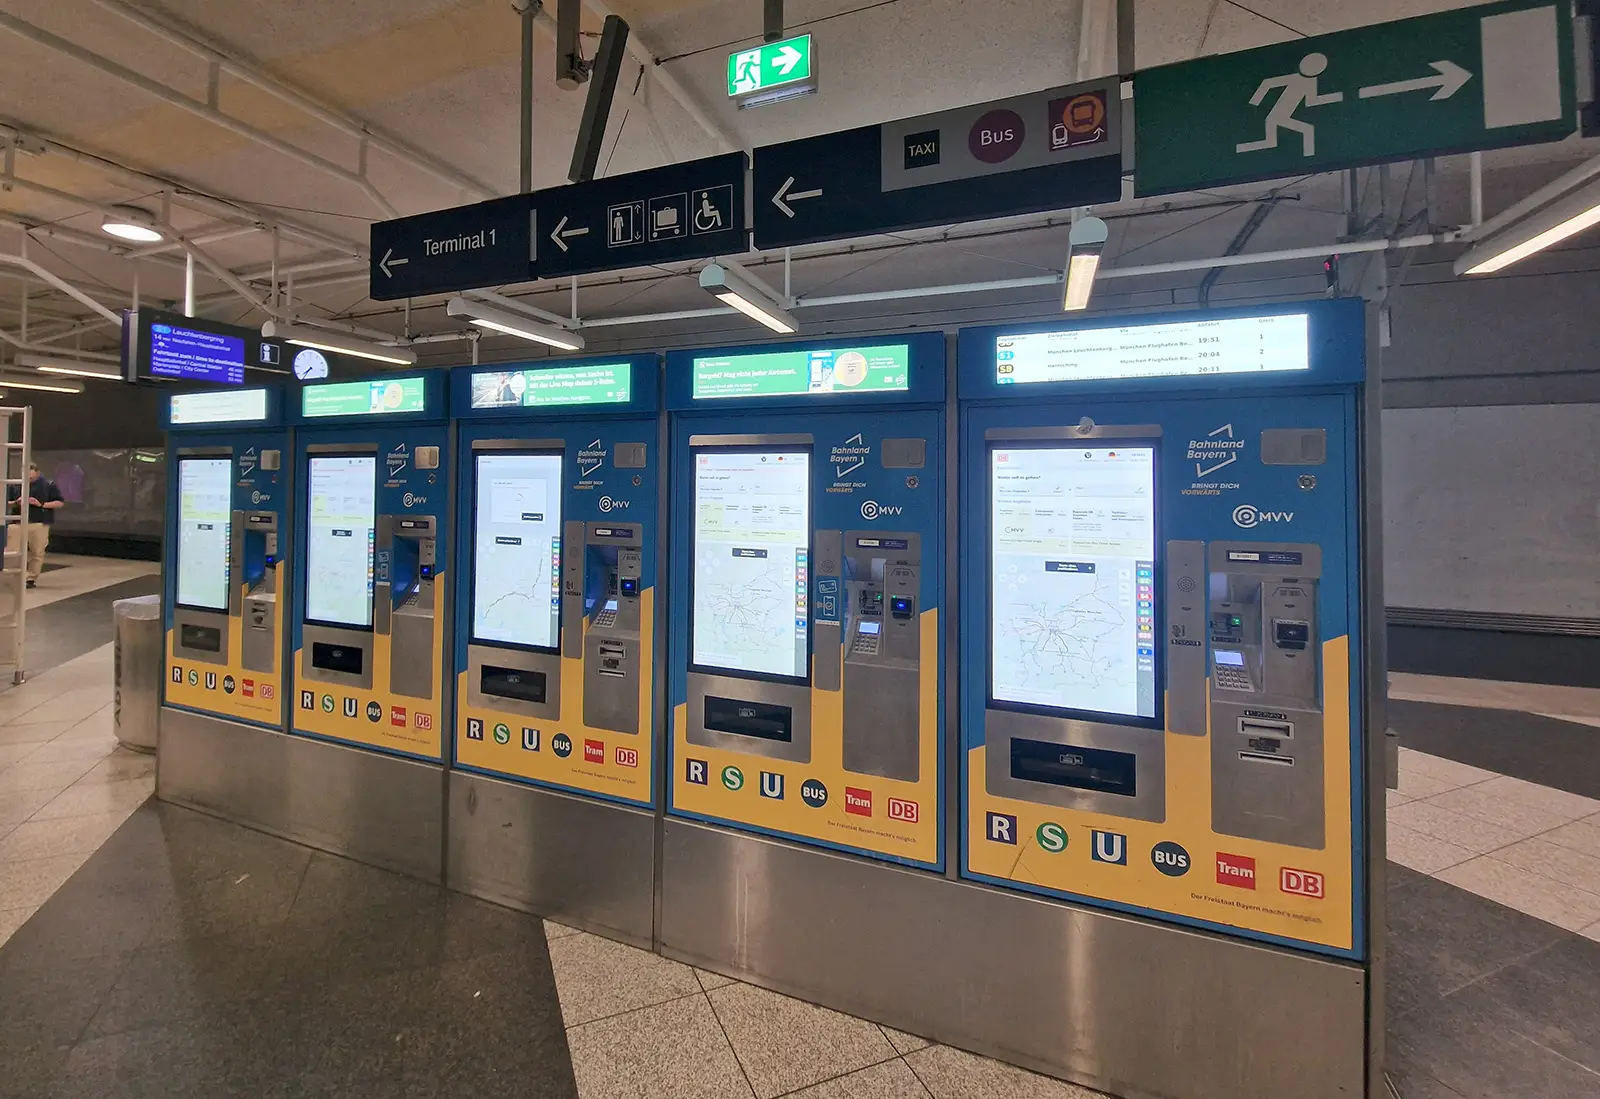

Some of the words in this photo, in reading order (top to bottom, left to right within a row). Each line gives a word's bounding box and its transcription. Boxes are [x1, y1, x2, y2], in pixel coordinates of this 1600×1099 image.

[980, 128, 1014, 146] Bus
[908, 142, 935, 157] TAXI
[423, 231, 486, 257] Terminal
[489, 229, 496, 246] 1
[1198, 336, 1220, 344] 19:51
[832, 446, 870, 454] Bahnland
[1189, 439, 1244, 449] Bahnland
[830, 455, 857, 464] Bayern
[1187, 450, 1226, 460] Bayern
[879, 506, 903, 515] MVV
[1260, 512, 1294, 522] MVV
[174, 668, 180, 681] R
[190, 670, 197, 684] S
[207, 673, 215, 689] U
[224, 680, 234, 689] BUS
[262, 687, 272, 696] DB
[304, 692, 312, 708] R
[324, 695, 333, 712] S
[346, 698, 356, 716] U
[368, 707, 380, 717] BUS
[417, 716, 430, 727] DB
[470, 721, 480, 738] R
[496, 725, 508, 743] S
[524, 729, 538, 749] U
[554, 740, 570, 751] BUS
[585, 745, 603, 757] Tram
[618, 750, 635, 764] DB
[690, 762, 703, 782] R
[725, 767, 740, 790] S
[763, 772, 780, 798] U
[803, 786, 825, 801] BUS
[845, 794, 870, 808] Tram
[892, 801, 915, 819] DB
[992, 817, 1010, 840] R
[1042, 825, 1062, 850] S
[1096, 833, 1122, 862] U
[1155, 850, 1186, 868] BUS
[1217, 860, 1254, 879] Tram
[1284, 870, 1319, 894] DB
[1204, 895, 1235, 906] Freistaat
[1236, 902, 1260, 911] Bayern
